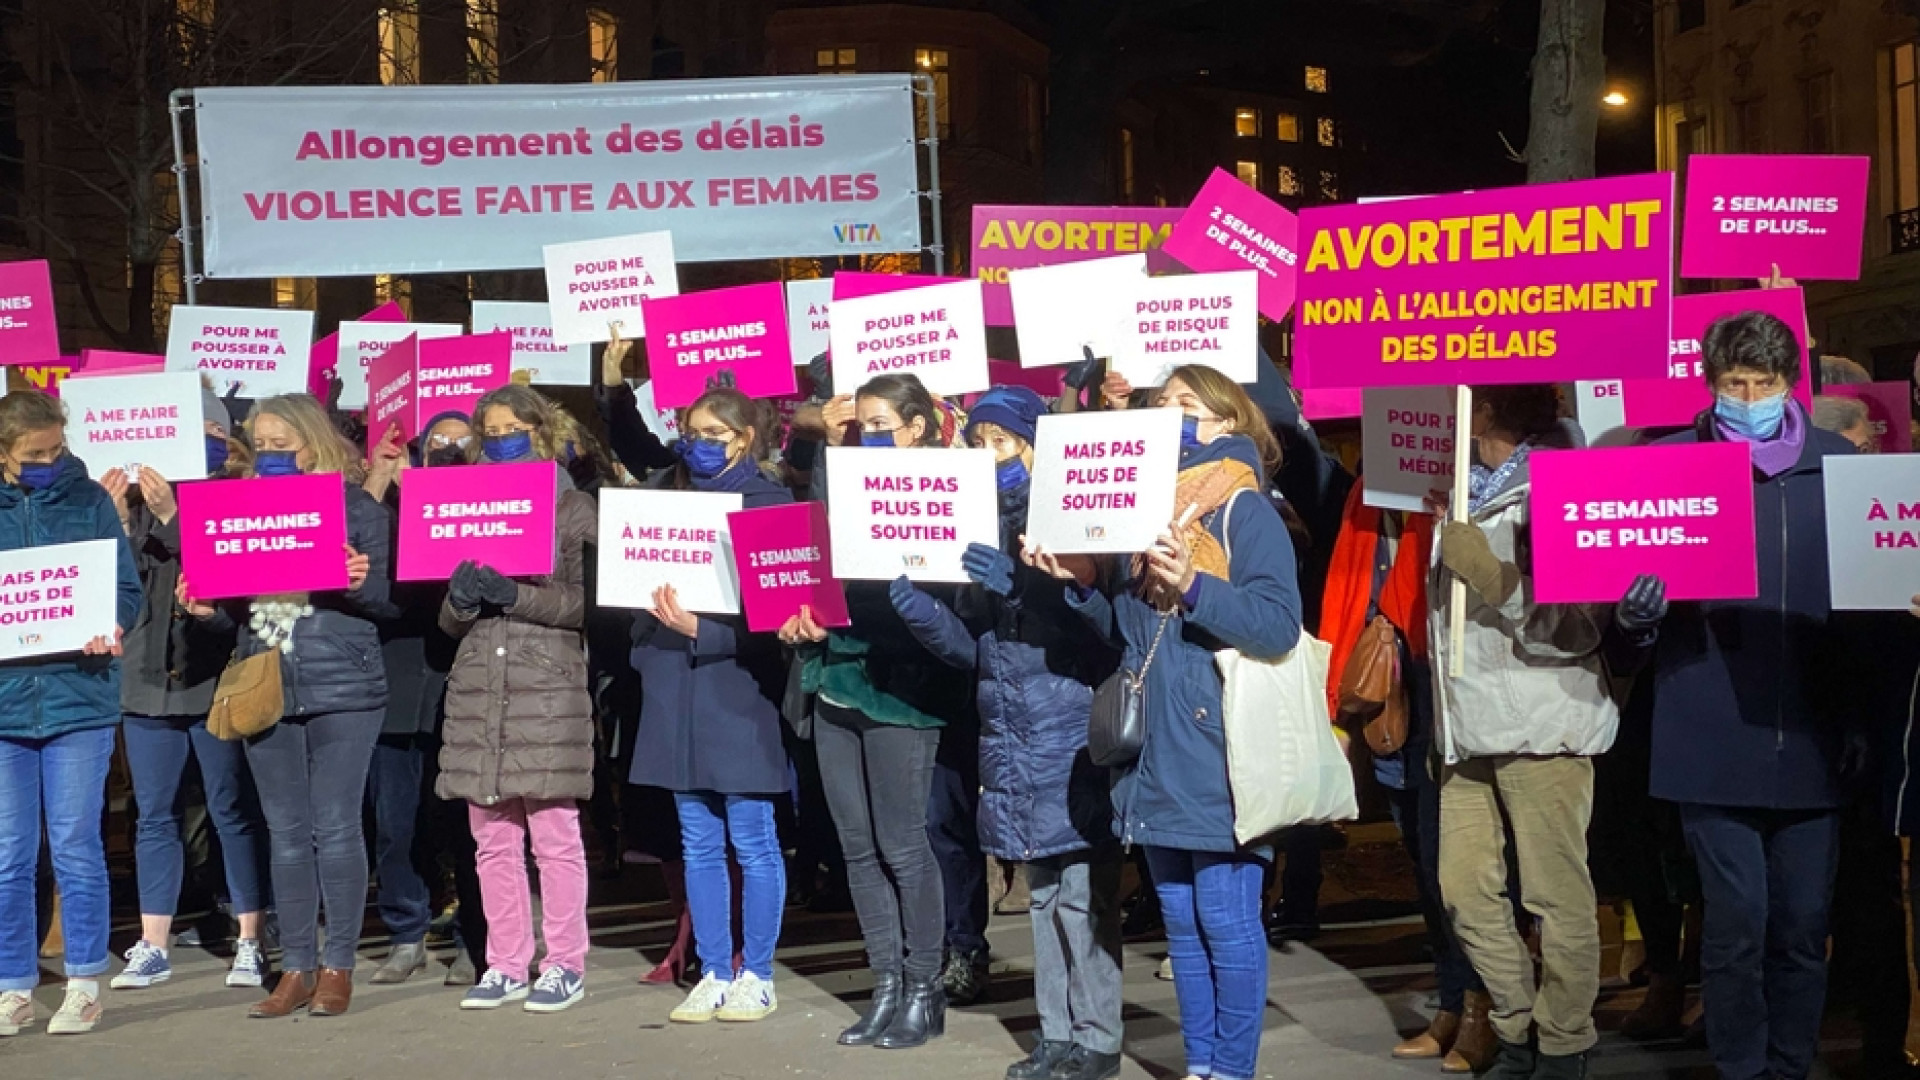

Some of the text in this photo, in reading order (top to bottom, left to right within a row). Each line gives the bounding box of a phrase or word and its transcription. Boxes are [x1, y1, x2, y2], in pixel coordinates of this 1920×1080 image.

[296, 115, 824, 166] Allongement des délais
[243, 172, 879, 221] VIOLENCE FAITE AUX FEMMES
[1712, 196, 1838, 212] 2 SEMAINES
[833, 223, 882, 243] VITA
[979, 220, 1172, 251] AVORTEM
[1210, 205, 1297, 266] 2 SEMAINES
[1305, 199, 1661, 273] AVORTEMENT
[1720, 219, 1827, 234] DE PLUS...
[1206, 224, 1277, 278] DE PLUS...
[575, 257, 644, 276] POUR ME
[978, 267, 1009, 284] NO
[569, 272, 654, 294] POUSSER À
[1136, 296, 1232, 314] POUR PLUS
[1303, 279, 1658, 325] NON À L'ALLONGEMENT
[865, 308, 947, 332] POUR ME
[1139, 317, 1230, 333] DE RISQUE
[202, 325, 279, 339] POUR ME
[666, 321, 766, 347] 2 SEMAINES
[857, 324, 958, 353] POUSSER À
[191, 340, 286, 355] POUSSER À
[359, 341, 389, 351] POU
[1145, 336, 1222, 353] MÉDICAL
[1381, 325, 1557, 362] DES DÉLAIS
[197, 358, 277, 372] AVORTER
[677, 345, 761, 366] DE PLUS...
[867, 349, 951, 373] AVORTER
[435, 382, 485, 397] PLUS...
[1594, 383, 1619, 397] DE
[84, 405, 178, 423] À ME FAIRE
[1387, 409, 1441, 428] POUR
[88, 426, 176, 442] HARCELER
[1391, 432, 1452, 453] DE RIS
[1064, 440, 1145, 459] MAIS PAS
[864, 477, 959, 492] MAIS PAS
[1066, 466, 1137, 484] PLUS DE
[423, 499, 532, 519] 2 SEMAINES
[871, 501, 953, 517] PLUS DE
[1062, 492, 1136, 510] SOUTIEN
[1563, 497, 1719, 521] 2 SEMAINES
[1866, 497, 1890, 521] À
[205, 512, 321, 535] 2 SEMAINES
[430, 521, 524, 539] DE PLUS...
[621, 522, 716, 543] À ME FAIRE
[871, 524, 957, 541] SOUTIEN
[215, 535, 314, 555] DE PLUS...
[1576, 526, 1709, 548] DE PLUS...
[625, 547, 713, 565] HARCELER
[749, 546, 820, 567] 2 SEMAINES
[0, 565, 79, 586] AIS PAS
[758, 573, 777, 589] DE
[0, 586, 73, 606] LUS DE
[0, 604, 74, 625] OUTIEN
